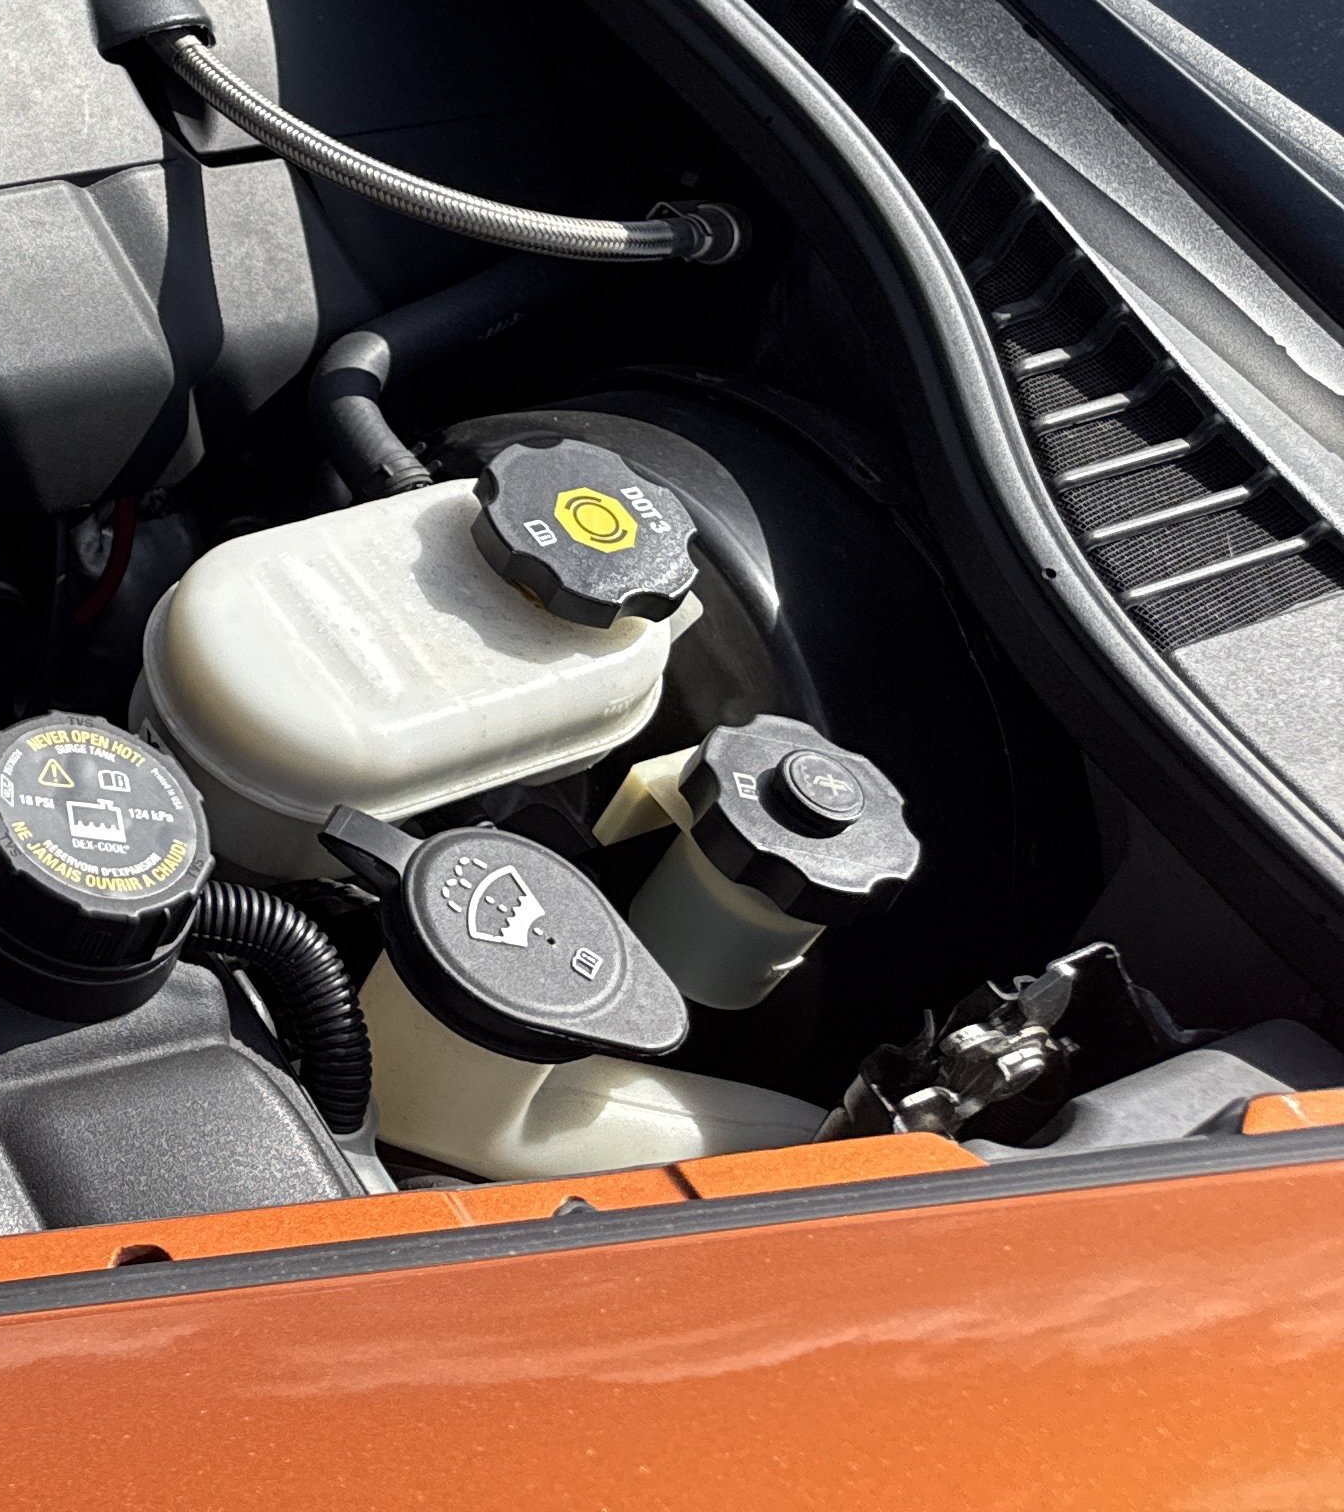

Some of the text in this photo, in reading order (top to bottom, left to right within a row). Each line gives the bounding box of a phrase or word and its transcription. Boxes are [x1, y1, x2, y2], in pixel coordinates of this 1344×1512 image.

[620, 485, 672, 535] DOT 3
[67, 715, 94, 729] TVS
[26, 728, 146, 768] NEVER OPEN HOT!
[54, 743, 117, 763] SURGE TANK
[34, 794, 55, 811] PSI
[128, 806, 175, 824] 124 kPa
[0, 834, 23, 858] TVS
[10, 819, 34, 843] NE
[25, 838, 83, 884] JAMAIS
[84, 873, 143, 893] OUVRIR
[150, 838, 190, 882] CHAUD!
